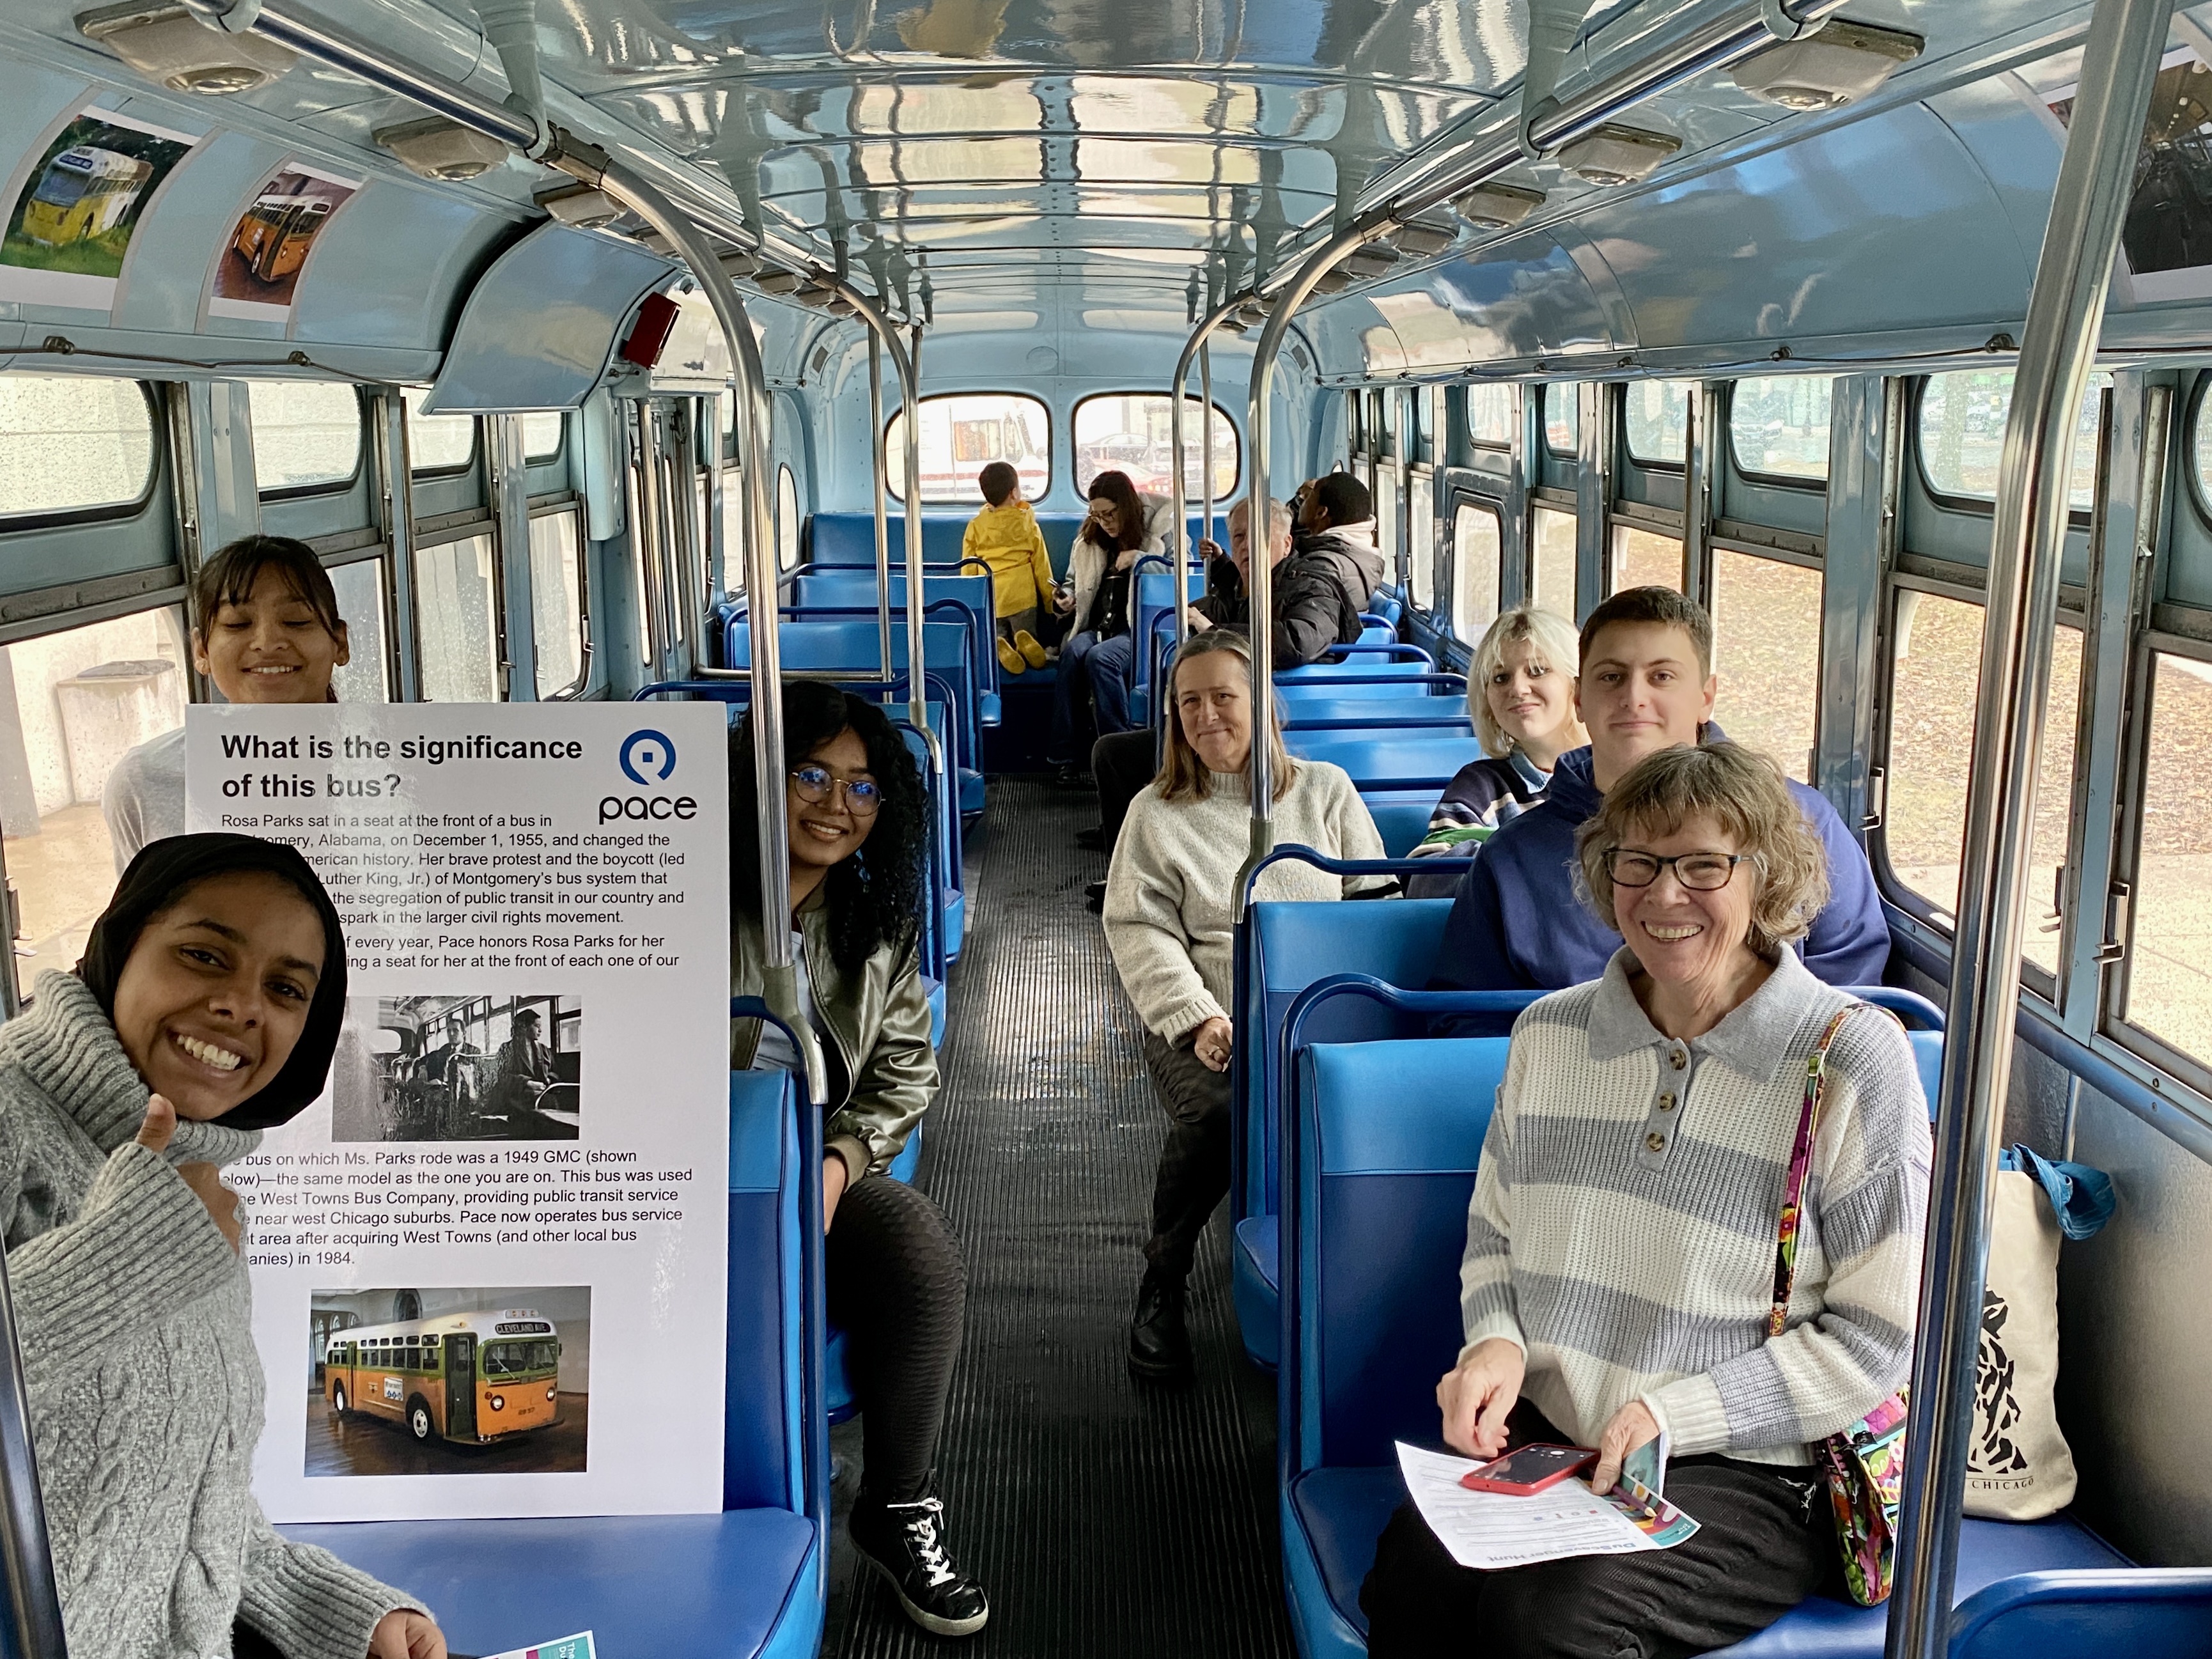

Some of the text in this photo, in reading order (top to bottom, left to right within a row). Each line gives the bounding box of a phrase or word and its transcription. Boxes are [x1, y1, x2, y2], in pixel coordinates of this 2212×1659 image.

[221, 735, 583, 765] What is the significance
[222, 773, 402, 798] of this bus?
[598, 796, 698, 825] pace
[221, 813, 552, 827] Rosa Parks sat in a seat at the front of a bus in
[253, 833, 670, 849] omery, Alabama, on December 1, 1955, and changed the
[304, 852, 685, 869] merican history. Her brave protest and the boycott (led
[366, 872, 402, 888] King,
[407, 871, 430, 888] Jr.)
[435, 871, 449, 885] of
[453, 871, 552, 888] Montgomery's
[556, 871, 582, 885] bus
[586, 871, 637, 887] system
[641, 871, 668, 884] that
[332, 891, 684, 907] the segregation of public transit in our country and
[339, 910, 624, 927] spark in the larger civil rights movement.
[355, 938, 395, 951] every
[398, 938, 433, 951] year,
[439, 935, 475, 948] Pace
[479, 935, 528, 948] honors
[532, 935, 569, 947] Rosa
[573, 934, 614, 947] Parks
[618, 934, 638, 947] for
[641, 934, 666, 947] her
[372, 958, 381, 968] a
[386, 954, 416, 968] seat
[419, 954, 440, 968] for
[444, 954, 467, 967] her
[471, 954, 485, 967] at
[488, 954, 511, 967] the
[514, 954, 548, 967] front
[551, 953, 566, 967] of
[568, 953, 604, 967] each
[607, 956, 635, 967] one
[638, 953, 653, 967] of
[656, 956, 680, 967] our
[245, 1154, 272, 1166] bus
[276, 1155, 294, 1166] on
[298, 1152, 339, 1165] which
[345, 1152, 370, 1165] Ms.
[375, 1151, 416, 1165] Parks
[420, 1151, 453, 1165] rode
[456, 1153, 485, 1164] was
[490, 1153, 499, 1164] a
[504, 1150, 539, 1164] 1949
[543, 1149, 581, 1164] GMC
[586, 1149, 637, 1166] (shown
[303, 1174, 343, 1185] same
[347, 1171, 391, 1185] model
[395, 1174, 413, 1185] as
[416, 1171, 440, 1185] the
[444, 1173, 471, 1184] one
[475, 1173, 501, 1187] you
[505, 1172, 529, 1183] are
[533, 1172, 556, 1183] on.
[559, 1169, 591, 1183] This
[595, 1169, 621, 1183] bus
[625, 1171, 654, 1182] was
[658, 1167, 692, 1181] used
[240, 1187, 678, 1207] he West Towns Bus Company, providing public transit service
[255, 1215, 289, 1226] near
[292, 1212, 326, 1225] west
[330, 1211, 389, 1227] Chicago
[393, 1210, 455, 1224] suburbs.
[460, 1210, 497, 1224] Pace
[501, 1212, 531, 1223] now
[534, 1209, 598, 1226] operates
[602, 1208, 628, 1222] bus
[632, 1207, 683, 1221] service
[258, 1235, 291, 1245] area
[295, 1231, 329, 1245] after
[332, 1230, 399, 1247] acquiring
[403, 1230, 440, 1244] West
[444, 1230, 492, 1243] Towns
[496, 1229, 528, 1246] (and
[533, 1229, 571, 1243] other
[574, 1228, 607, 1242] local
[611, 1227, 637, 1242] bus
[249, 1251, 355, 1268] anies) in 1984.
[1972, 1478, 2034, 1490] CHICAGO
[566, 1642, 576, 1659] The
